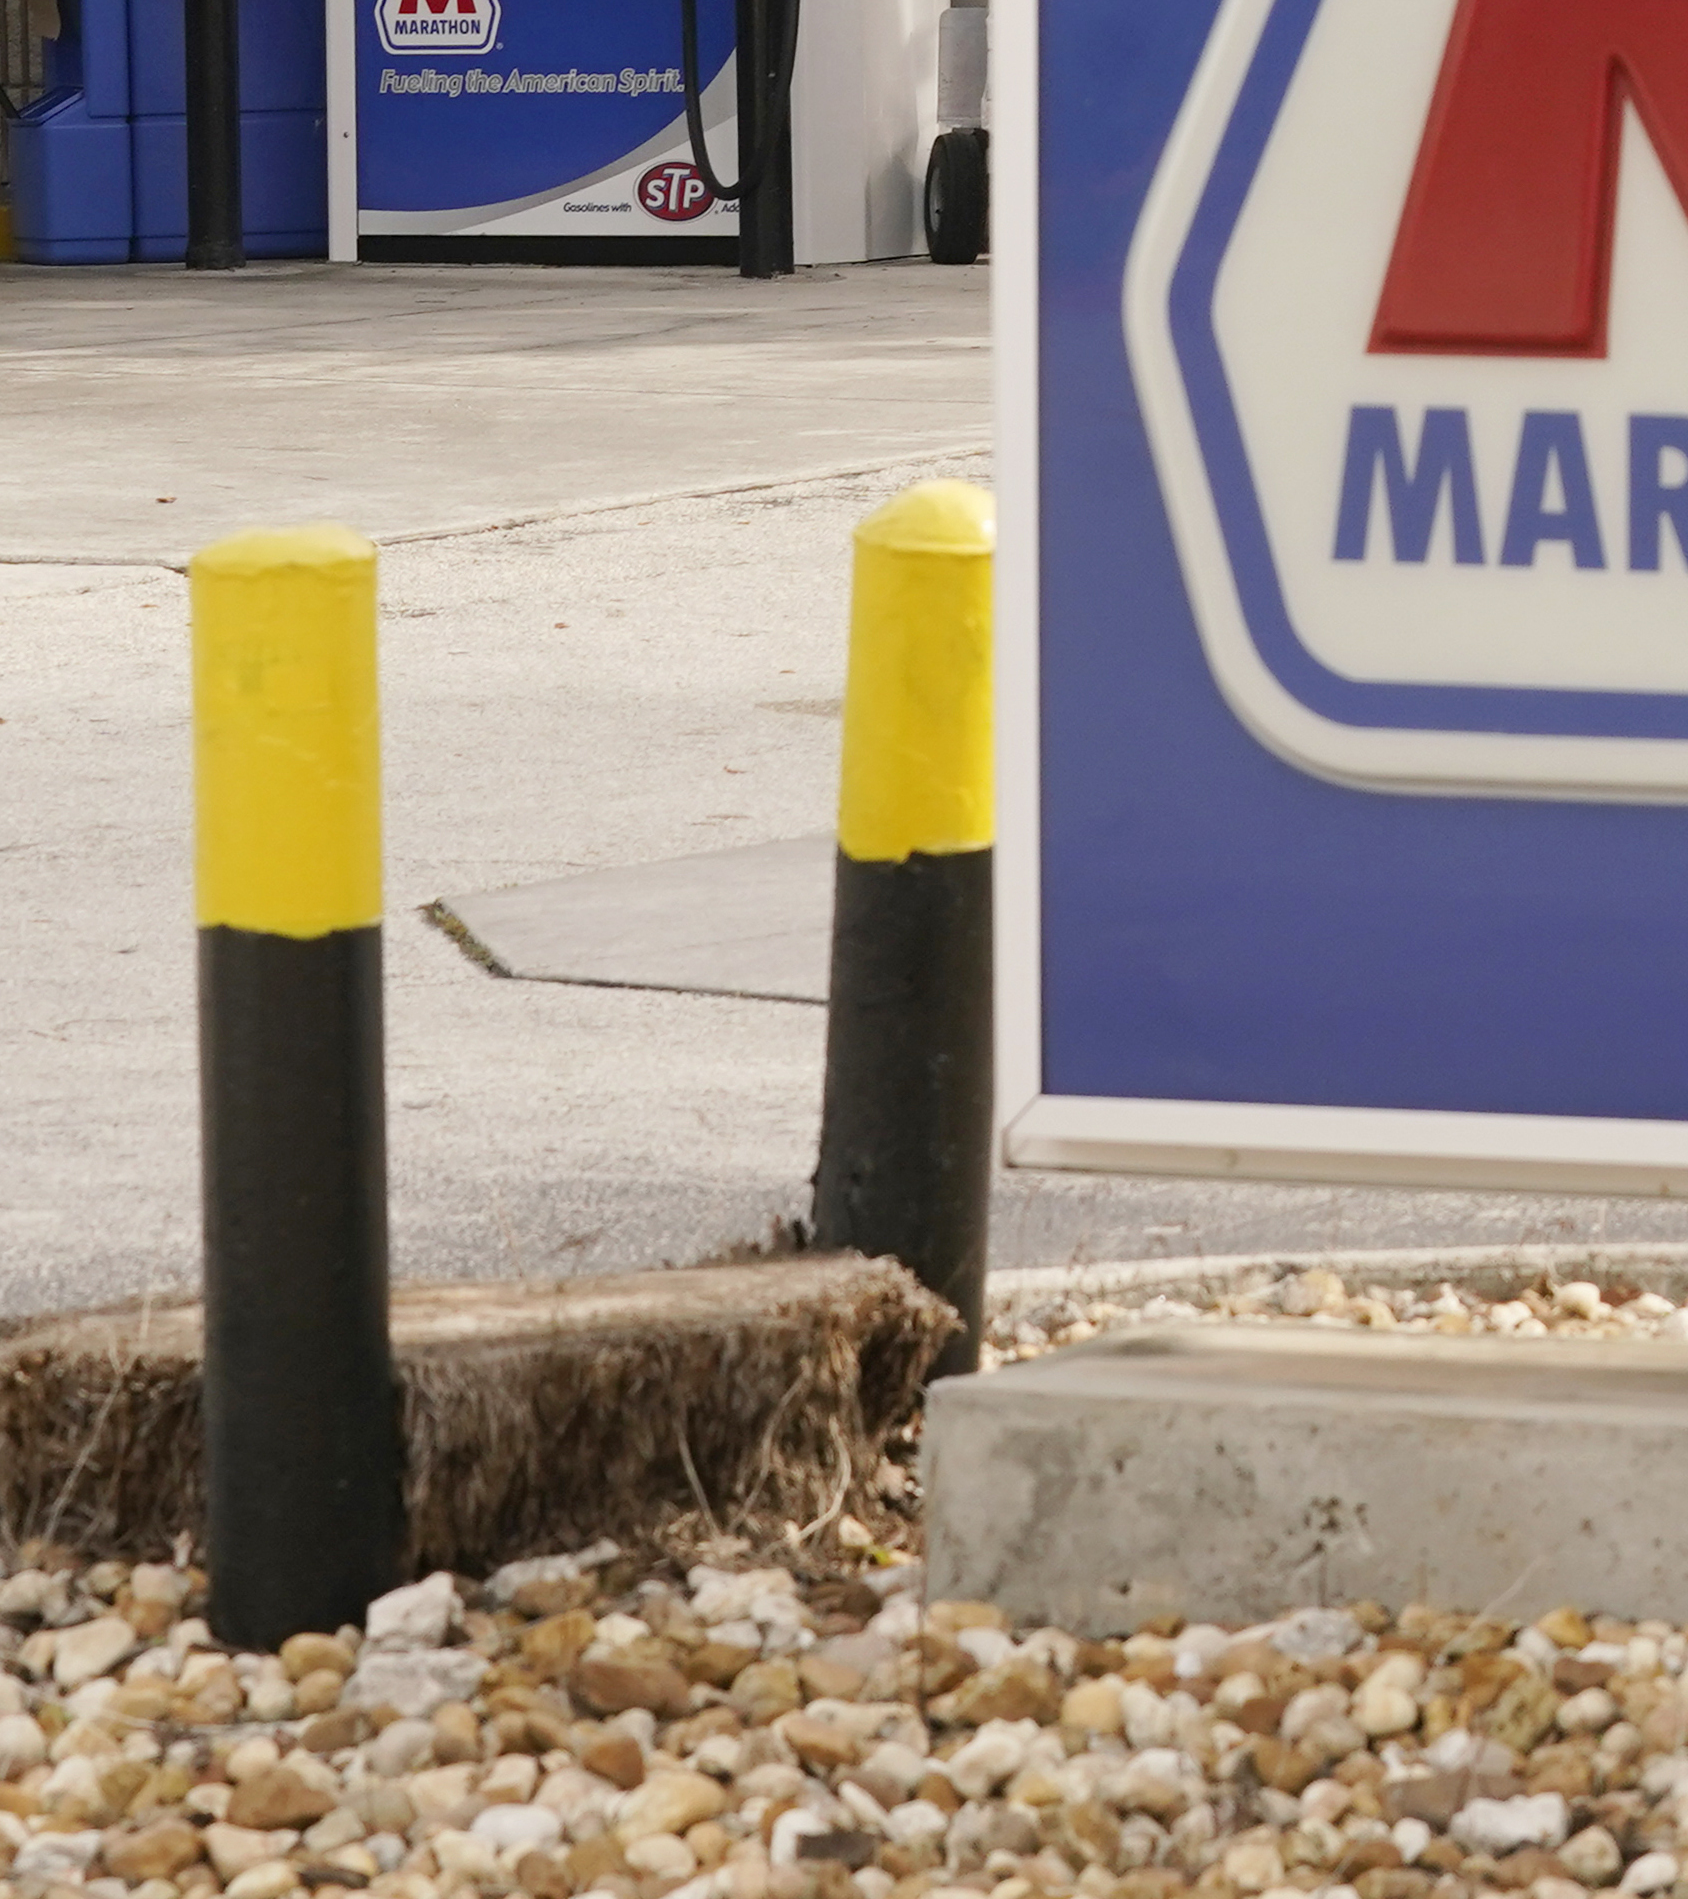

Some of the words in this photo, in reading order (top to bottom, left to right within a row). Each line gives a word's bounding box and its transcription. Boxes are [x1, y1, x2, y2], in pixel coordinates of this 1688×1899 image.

[394, 20, 481, 35] MARATHON
[380, 69, 463, 98] Fueling
[465, 69, 502, 93] the
[502, 68, 616, 93] American
[618, 67, 686, 98] Spirit.
[645, 167, 706, 213] STP
[563, 202, 610, 213] Gasolines
[611, 202, 632, 212] with
